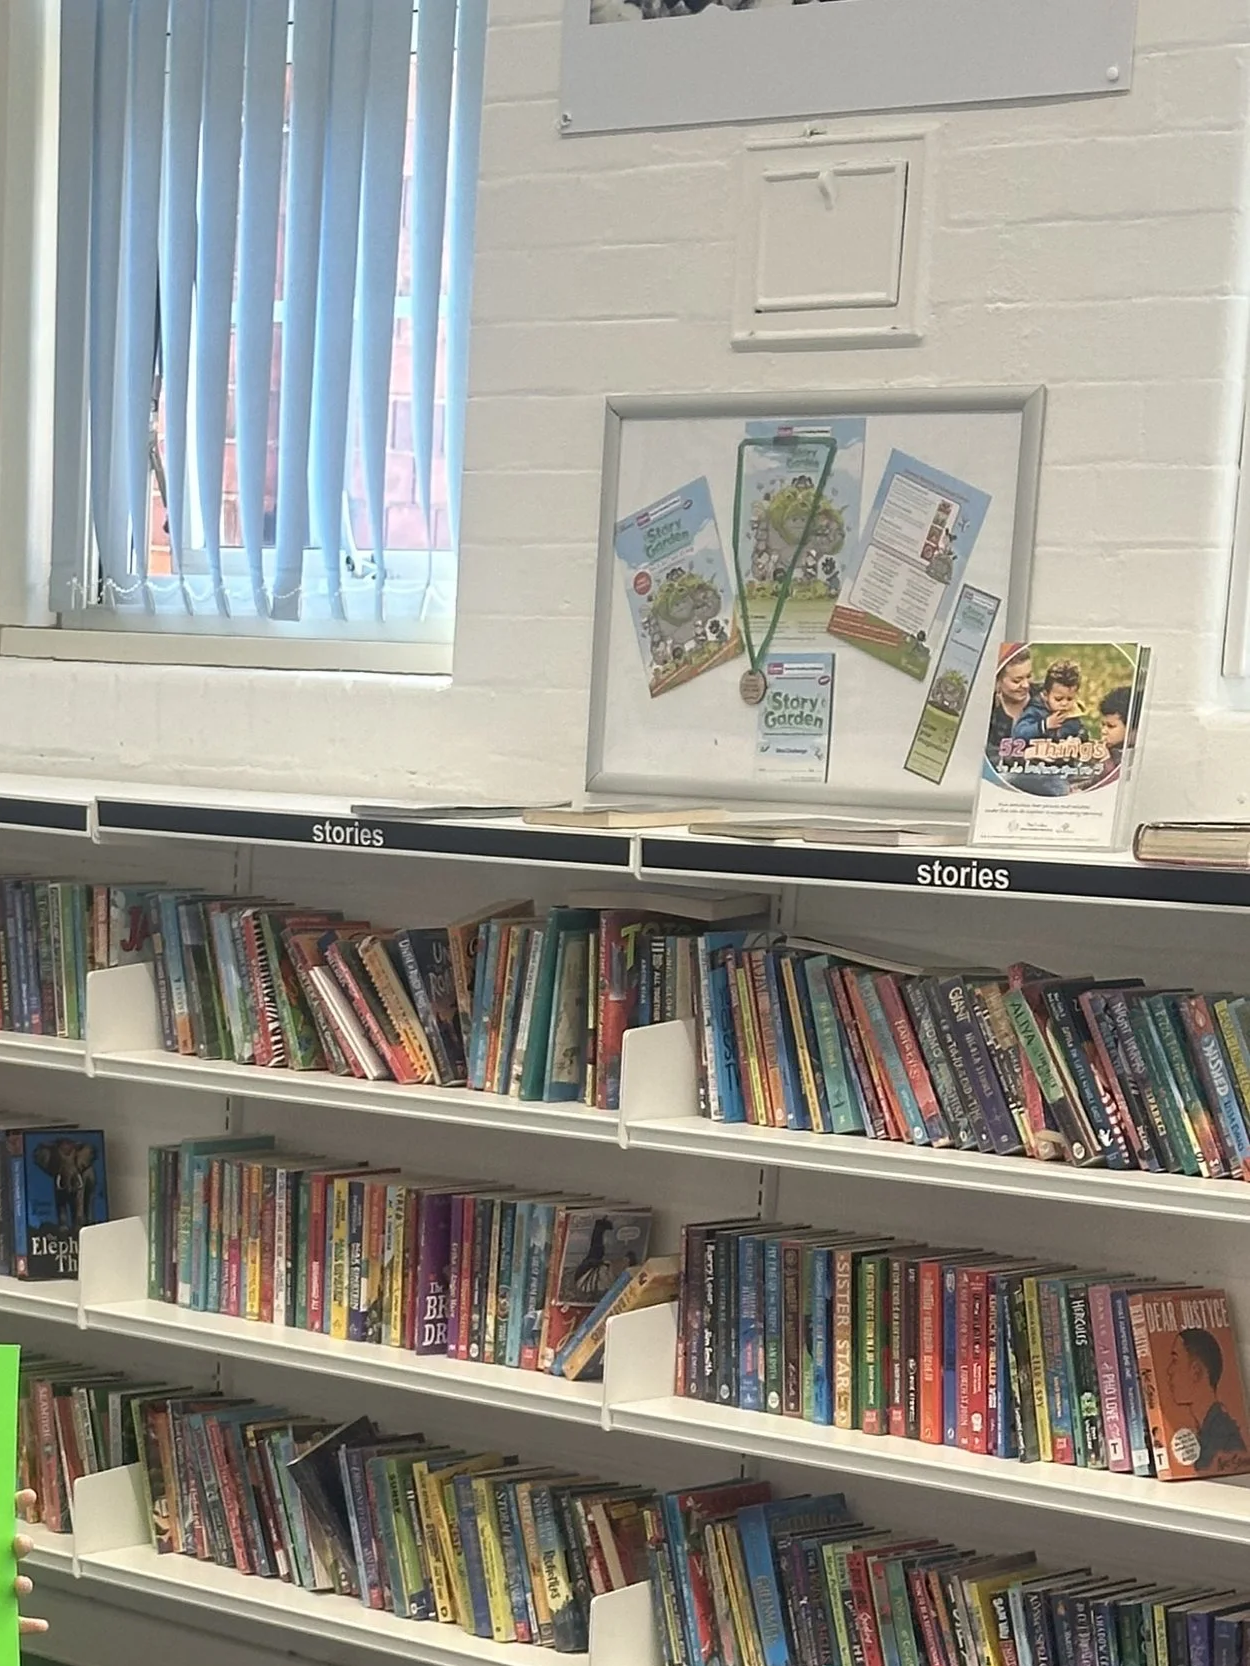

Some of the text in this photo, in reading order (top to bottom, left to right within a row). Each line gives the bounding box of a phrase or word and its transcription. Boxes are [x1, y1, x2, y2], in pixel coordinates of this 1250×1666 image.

[646, 518, 682, 540] Story
[771, 691, 819, 712] Story
[764, 710, 824, 729] Garden
[999, 736, 1108, 763] 52 Things
[311, 820, 385, 848] stories
[916, 860, 1011, 891] stories
[653, 971, 661, 984] ALL
[946, 985, 970, 1024] GIANT
[1110, 1001, 1133, 1035] NIGHT
[1009, 1000, 1037, 1046] ALIYA
[1201, 1038, 1230, 1098] WISHED
[31, 1235, 79, 1256] Eleph
[429, 1282, 445, 1294] The
[704, 1244, 715, 1304] Barry Loser
[835, 1261, 849, 1325] SISTER
[1070, 1299, 1089, 1346] HERCULES
[1145, 1298, 1230, 1333] DEAR JUSTYCE
[702, 1328, 713, 1375] Jim Smith
[988, 1294, 996, 1385] KENTUCKY THRILLER
[1034, 1389, 1043, 1408] SPY
[1101, 1372, 1119, 1422] PHO LOVE
[1110, 1442, 1118, 1455] T
[1156, 1453, 1164, 1467] T
[494, 1489, 513, 1533] STORM
[991, 1597, 1007, 1621] SAM
[1094, 1614, 1106, 1653] SHADOW
